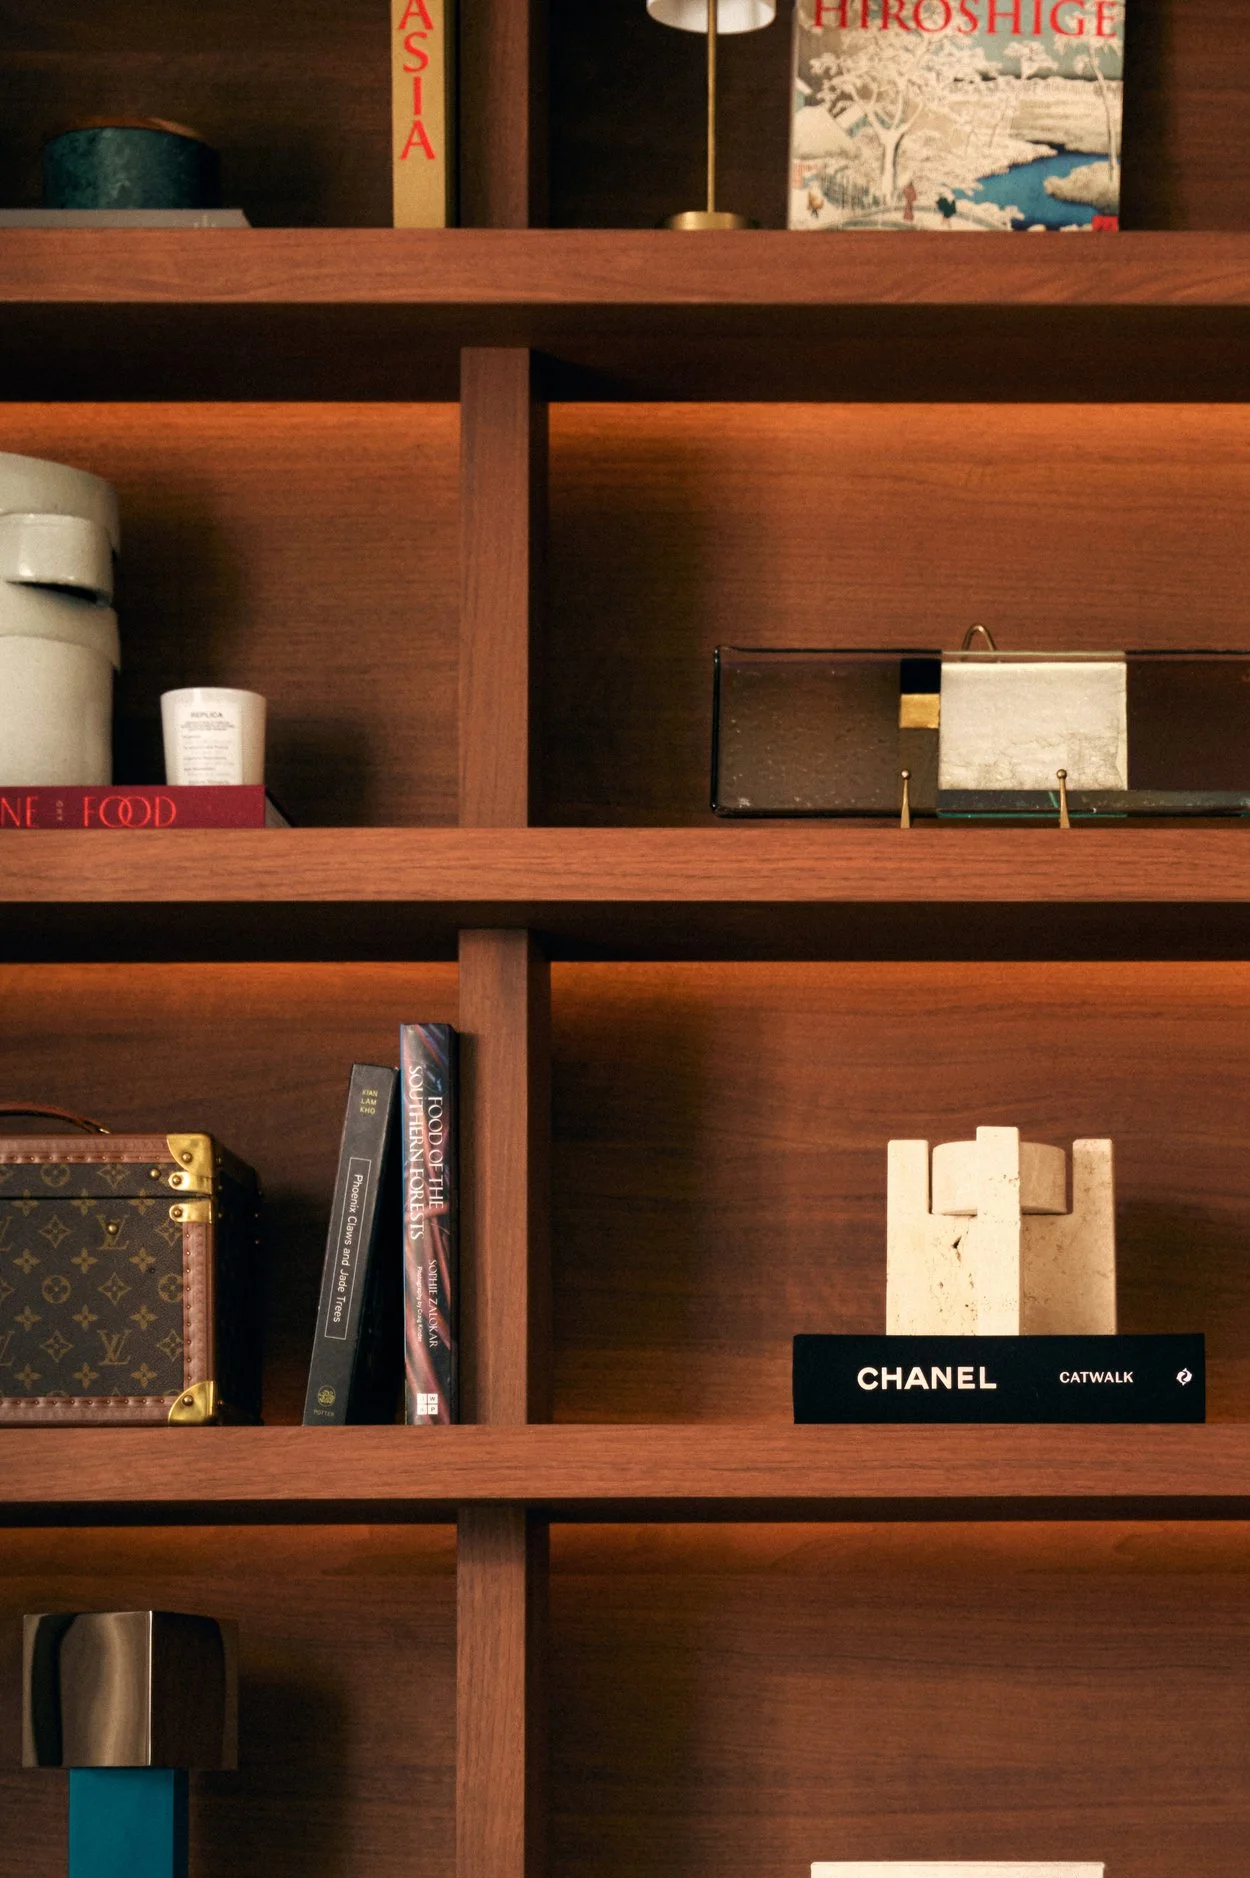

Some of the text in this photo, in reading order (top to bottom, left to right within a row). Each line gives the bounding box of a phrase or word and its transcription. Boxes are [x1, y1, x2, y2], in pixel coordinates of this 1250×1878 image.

[813, 0, 1118, 38] HIROSHIGE
[399, 0, 436, 160] ASIA
[83, 795, 177, 829] FOOD
[360, 1097, 377, 1106] LAM
[408, 1065, 425, 1241] SOUTHERN FORESTS
[428, 1096, 444, 1209] FOOD OF THE
[333, 1173, 364, 1323] Phoenix Claws and Jade Trees
[428, 1259, 439, 1348] SOPHIE ZALOKAR
[857, 1366, 998, 1391] CHANEL
[1059, 1371, 1134, 1384] CATWALK
